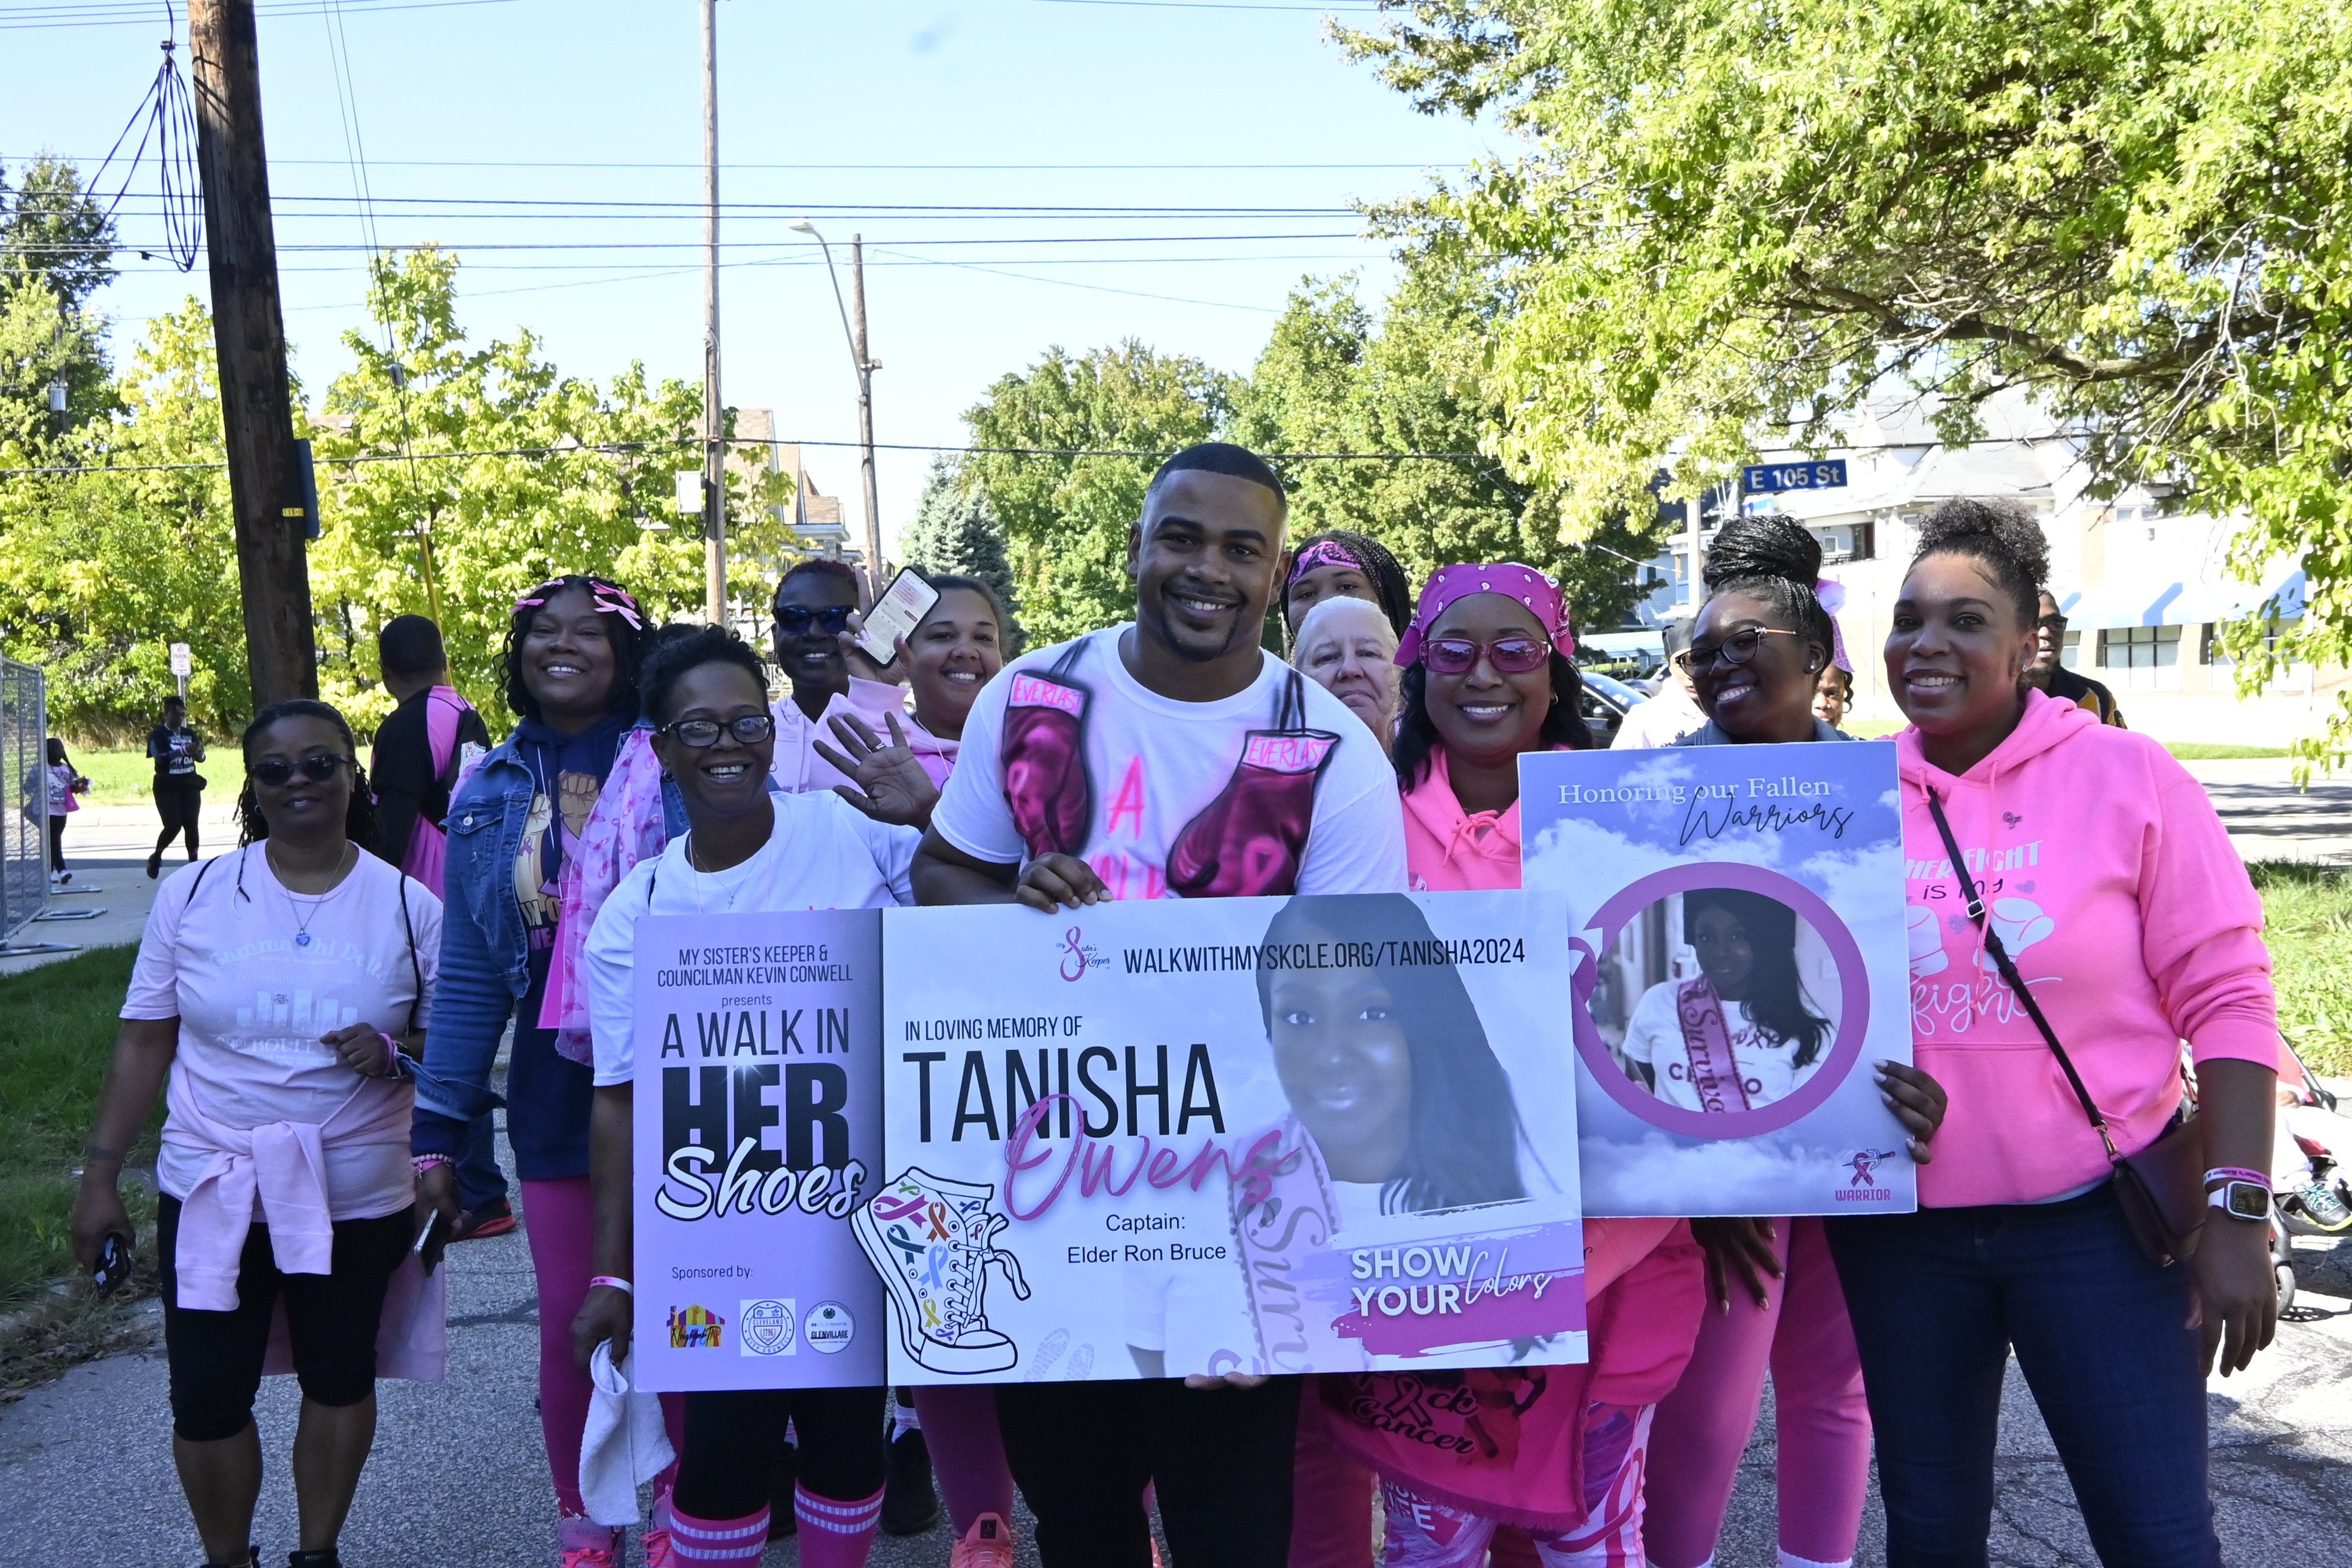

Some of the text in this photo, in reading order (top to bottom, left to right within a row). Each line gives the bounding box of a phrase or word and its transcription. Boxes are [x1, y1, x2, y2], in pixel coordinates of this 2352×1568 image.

[1751, 465, 1840, 489] E 105 St
[1248, 737, 1334, 768] EVERLAST
[1558, 776, 1832, 806] Honoring our Fallen
[1679, 786, 1854, 847] Warriors
[1923, 885, 1947, 900] is
[679, 944, 828, 966] MY SISTER'S KEEPER &
[1074, 953, 1110, 969] Keeper
[1123, 938, 1526, 975] WALKWITHMYSKCLE.ORG/TANISHA2024
[657, 964, 854, 987] COUNCILMAN KEVIN CONWELL
[721, 994, 773, 1009] presents
[662, 1007, 850, 1059] A WALK IN
[905, 1016, 1083, 1041] IN LOVING MEMORY OF
[902, 1043, 1227, 1143] TANISHA
[662, 1061, 850, 1175] HER
[1004, 1093, 1303, 1222] Owens
[655, 1136, 868, 1222] Shoes
[1835, 1189, 1891, 1202] WARRIOR
[1105, 1213, 1186, 1236] Captain:
[1067, 1244, 1227, 1265] Elder Ron Bruce
[1350, 1245, 1472, 1280] SHOW
[672, 1265, 754, 1282] Sponsored by:
[1350, 1246, 1552, 1318] YOUR Colors
[762, 1328, 774, 1337] 1796
[810, 1330, 849, 1339] GLENVILLAGE
[746, 1337, 791, 1353] CITY COUNCIL
[1350, 1395, 1477, 1454] Cancer
